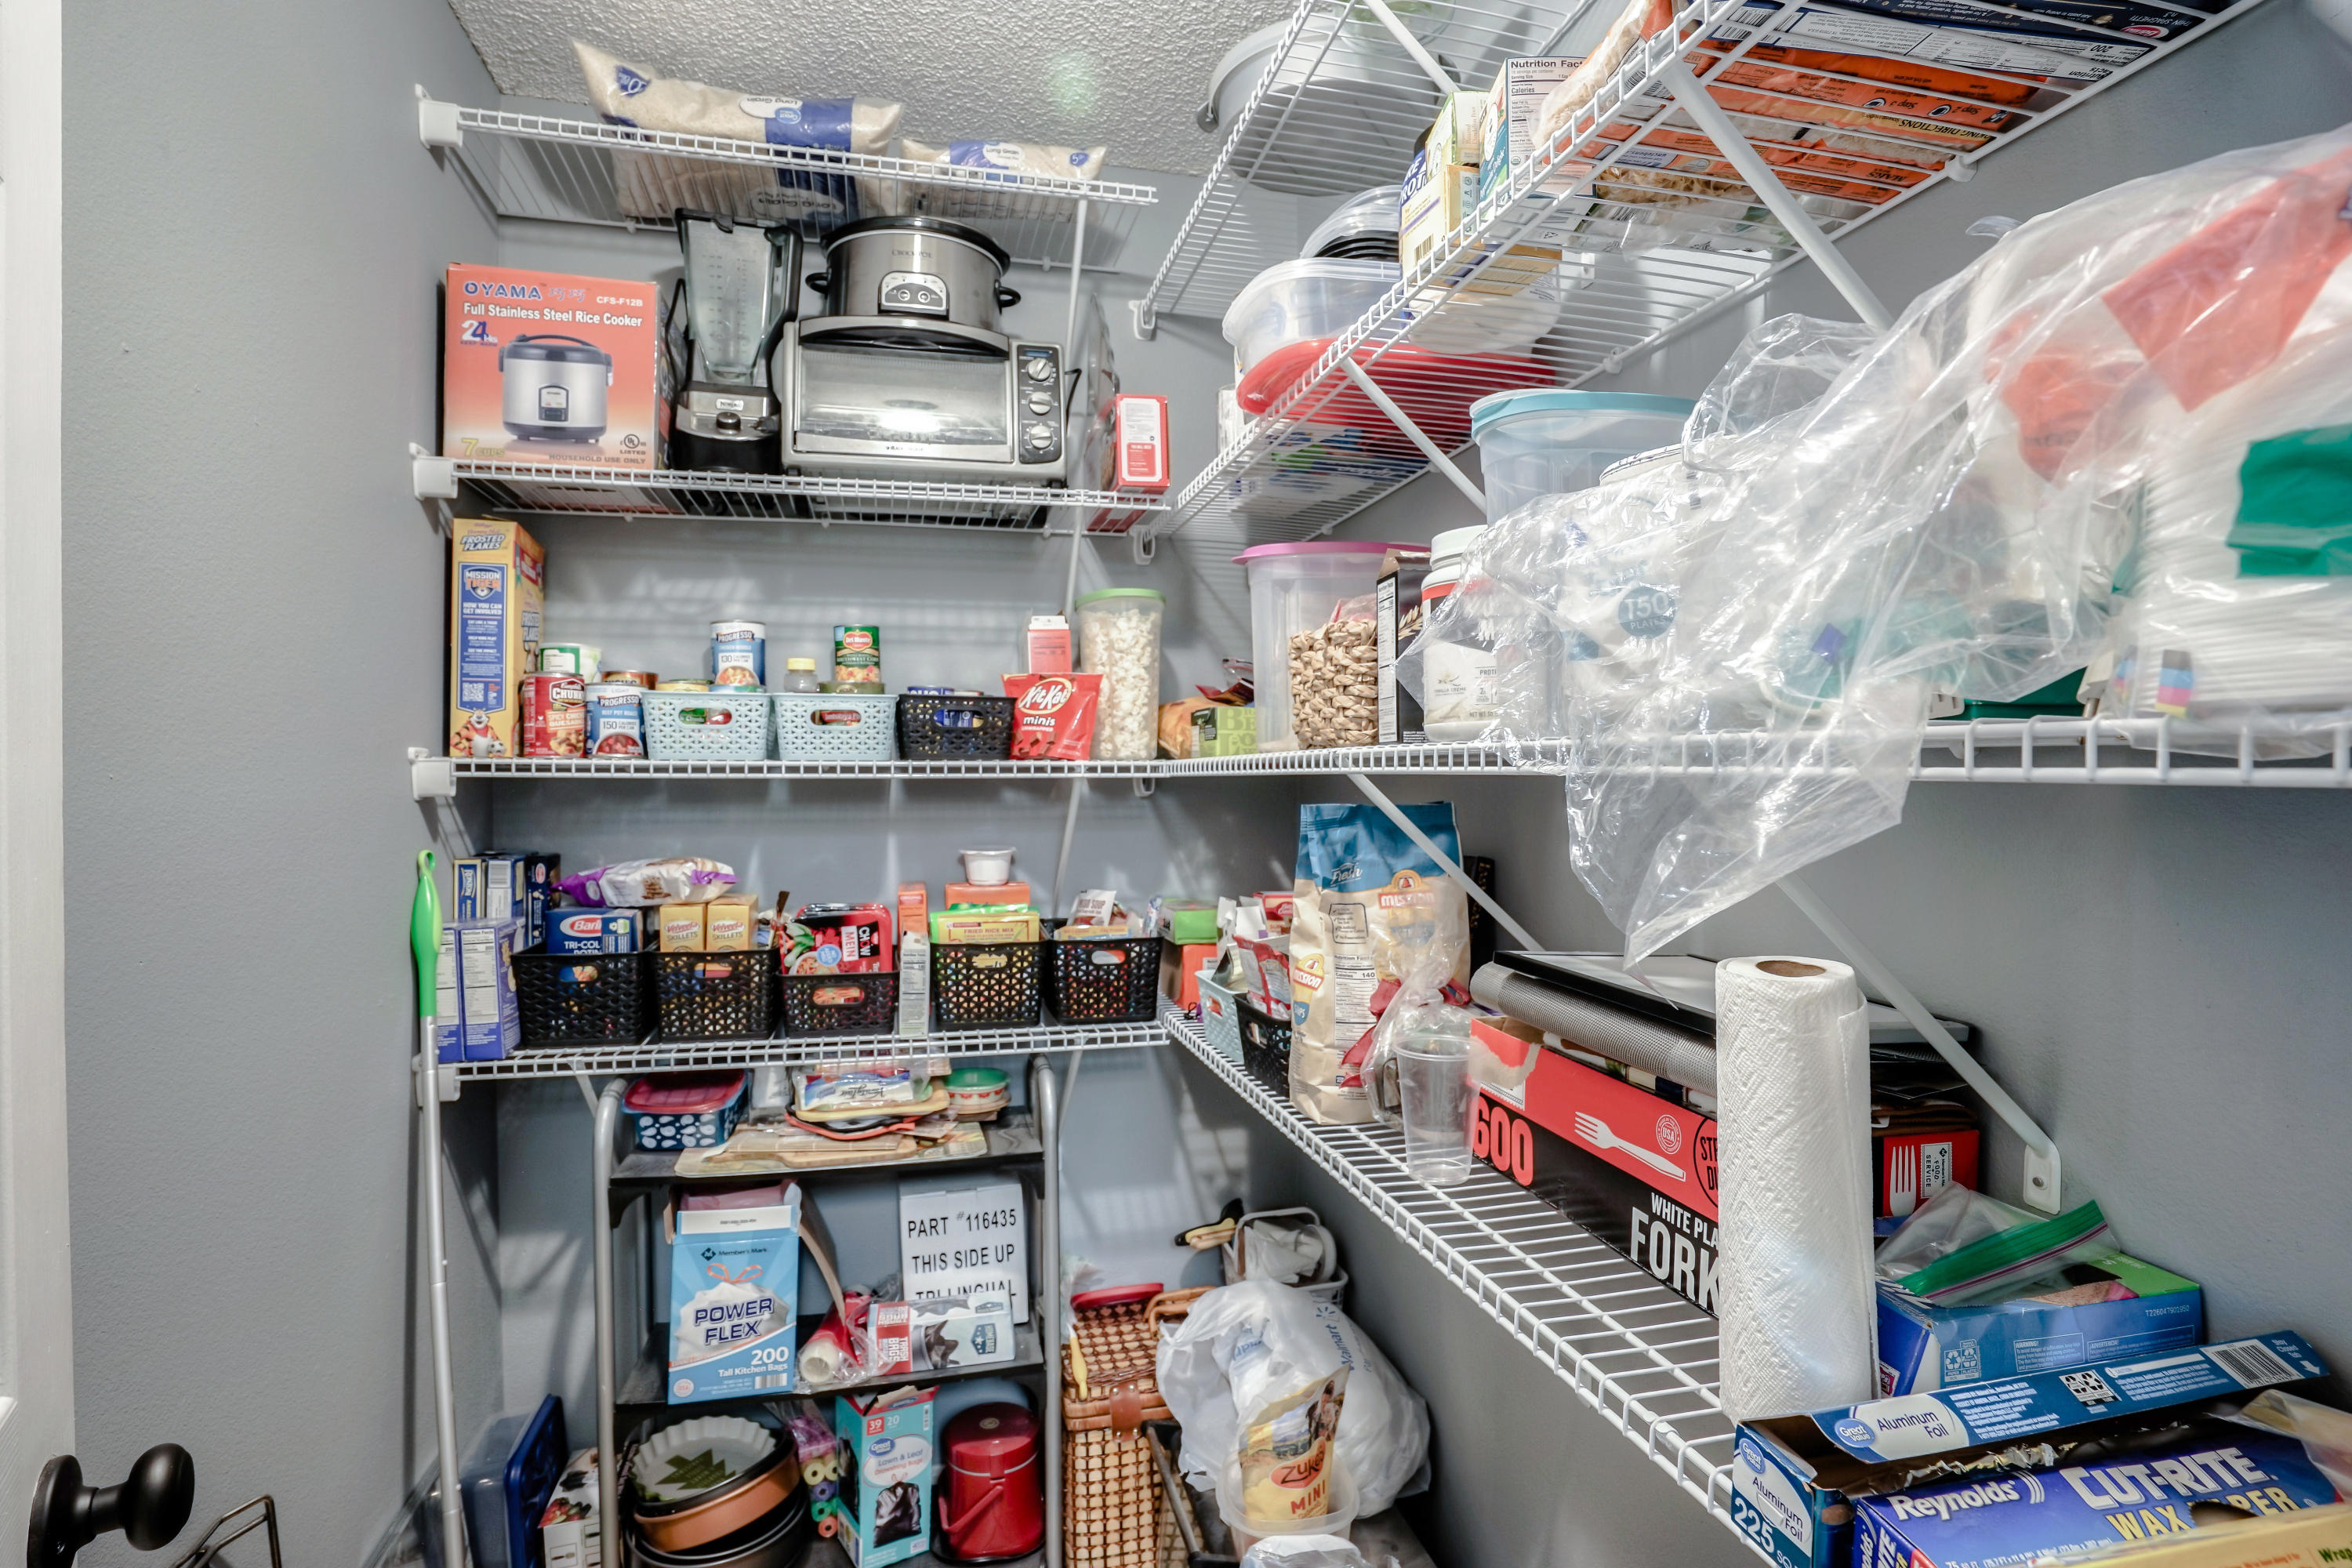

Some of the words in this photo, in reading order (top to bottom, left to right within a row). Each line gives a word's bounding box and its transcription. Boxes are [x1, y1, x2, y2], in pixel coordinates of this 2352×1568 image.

[2129, 15, 2170, 25] SPAGHETTI
[1897, 100, 1918, 109] Step
[1962, 106, 1982, 115] Step
[1869, 172, 1907, 182] MARS
[464, 281, 543, 300] OYAMA
[596, 296, 644, 307] CFS-F12B
[463, 303, 485, 316] Full
[488, 304, 541, 320] Stainless
[543, 308, 573, 322] Steel
[575, 310, 600, 324] Rice
[603, 313, 642, 327] Cooker
[461, 437, 478, 457] 7
[475, 446, 505, 458] CUPS
[549, 453, 601, 463] HOUSEHOLD
[622, 456, 645, 465] ONLY
[461, 534, 506, 544] FROSTED
[463, 542, 501, 552] FLAKES
[1630, 615, 1665, 630] PLATES
[717, 631, 752, 643] PROGRESSO
[720, 654, 732, 663] 130
[600, 695, 640, 707] PROGRESSO
[602, 720, 618, 729] 150
[1023, 716, 1056, 727] minis
[1331, 864, 1363, 884] Fresh
[666, 920, 699, 932] Velveeta
[711, 920, 744, 932] Velveeta
[667, 931, 699, 941] SKILLETS
[712, 931, 743, 941] SKILLETS
[845, 931, 855, 958] MEIN
[858, 926, 871, 956] CHOW
[1473, 1096, 1534, 1186] 600
[1662, 1127, 1675, 1142] USA
[1651, 1192, 1691, 1236] WHITE
[908, 1216, 949, 1238] PART
[956, 1208, 1017, 1233] #116435
[912, 1252, 948, 1274] THIS
[953, 1247, 989, 1269] SIDE
[995, 1243, 1015, 1263] UP
[694, 1298, 774, 1325] POWER
[705, 1319, 760, 1345] FLEX
[751, 1346, 789, 1366] 200
[900, 1336, 909, 1361] TRASH
[735, 1367, 767, 1376] Kitchen
[768, 1363, 788, 1372] Bags
[869, 1419, 883, 1431] 39
[887, 1414, 900, 1426] 20
[1876, 1410, 1940, 1432] Aluminum
[1840, 1425, 1867, 1438] Great
[1849, 1432, 1871, 1442] Value
[1923, 1423, 1949, 1439] Foil
[871, 1440, 892, 1451] Great
[877, 1455, 898, 1467] Lawn
[906, 1449, 924, 1460] Leaf
[1742, 1443, 1762, 1466] Great
[1746, 1453, 1762, 1471] Value
[874, 1463, 906, 1476] Drawstring
[908, 1458, 924, 1468] Bags
[2060, 1447, 2272, 1510] CUT-RITE
[1290, 1479, 1326, 1515] MINI
[1752, 1475, 1804, 1529] Aluminum
[1733, 1497, 1775, 1554] 225
[2106, 1504, 2195, 1541] WAX
[1784, 1519, 1803, 1544] Foil
